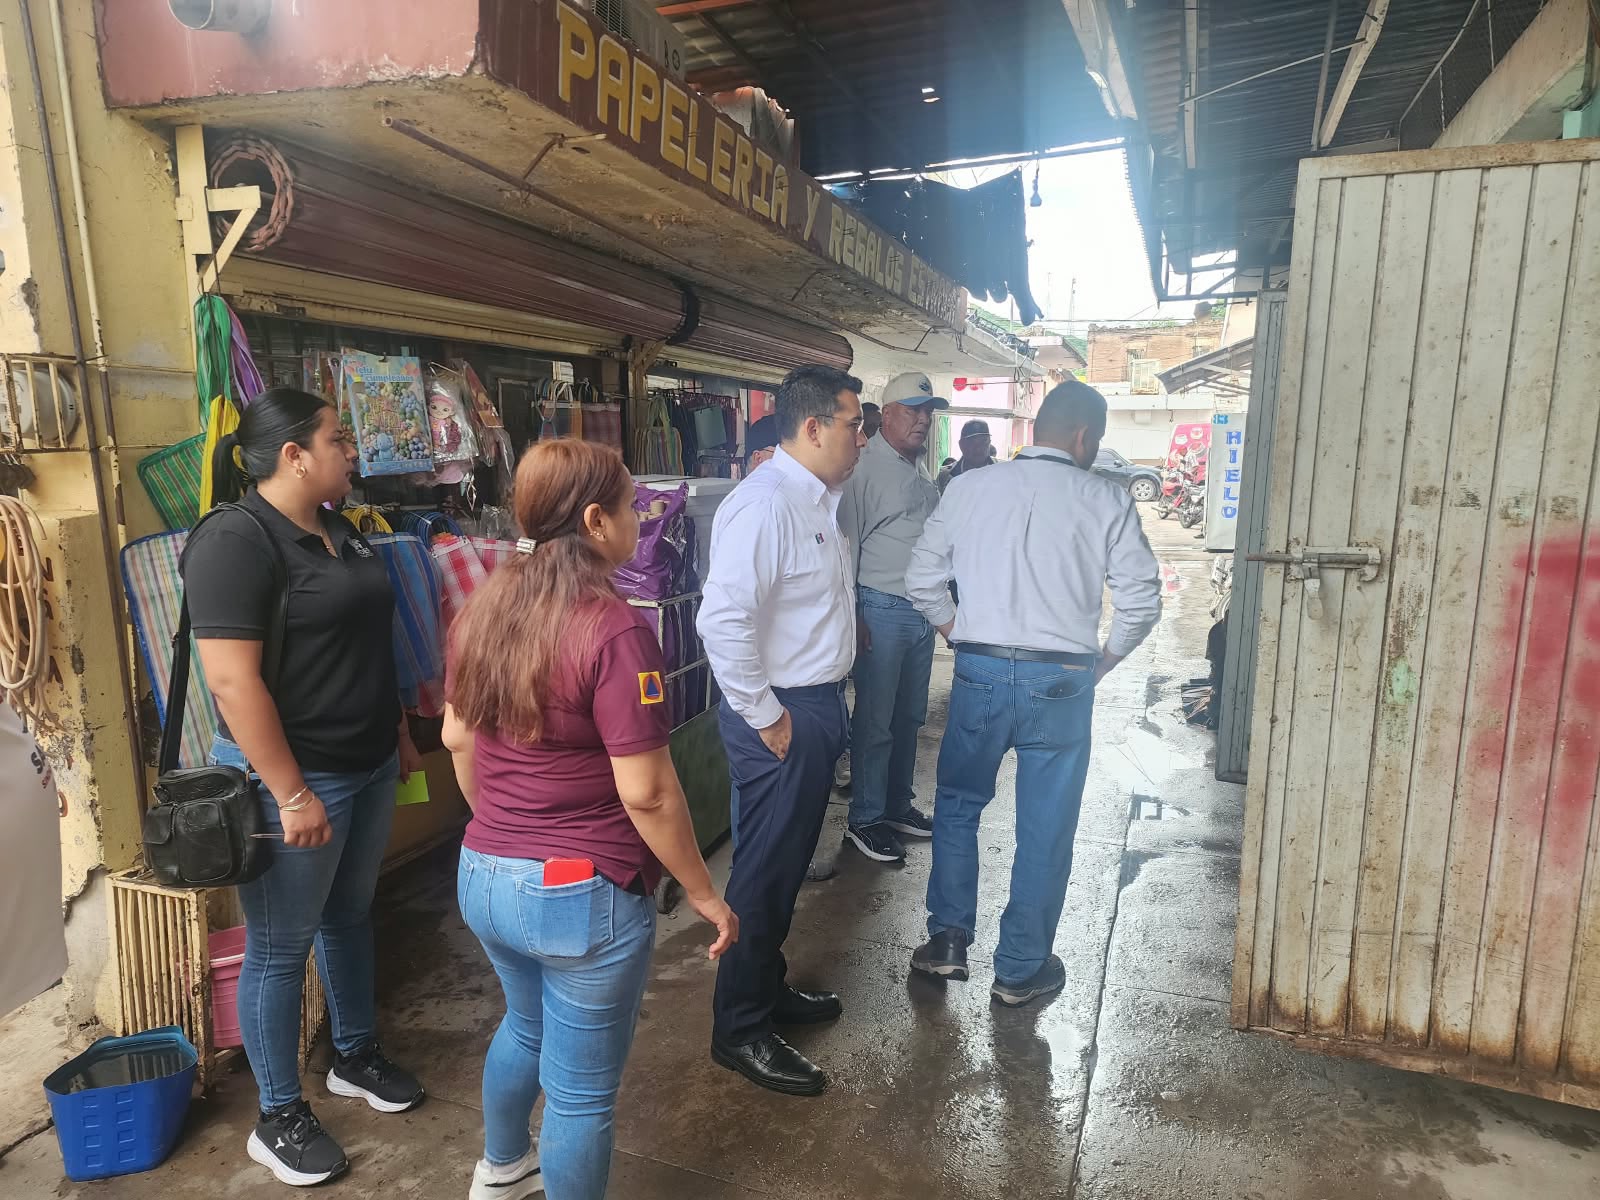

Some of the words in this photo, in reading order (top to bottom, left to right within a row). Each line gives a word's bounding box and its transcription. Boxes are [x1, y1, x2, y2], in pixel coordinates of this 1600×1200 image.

[557, 1, 789, 229] PAPELERIA
[803, 184, 820, 241] Y
[829, 202, 904, 297] REGALOS
[1221, 431, 1242, 519] HIELO
